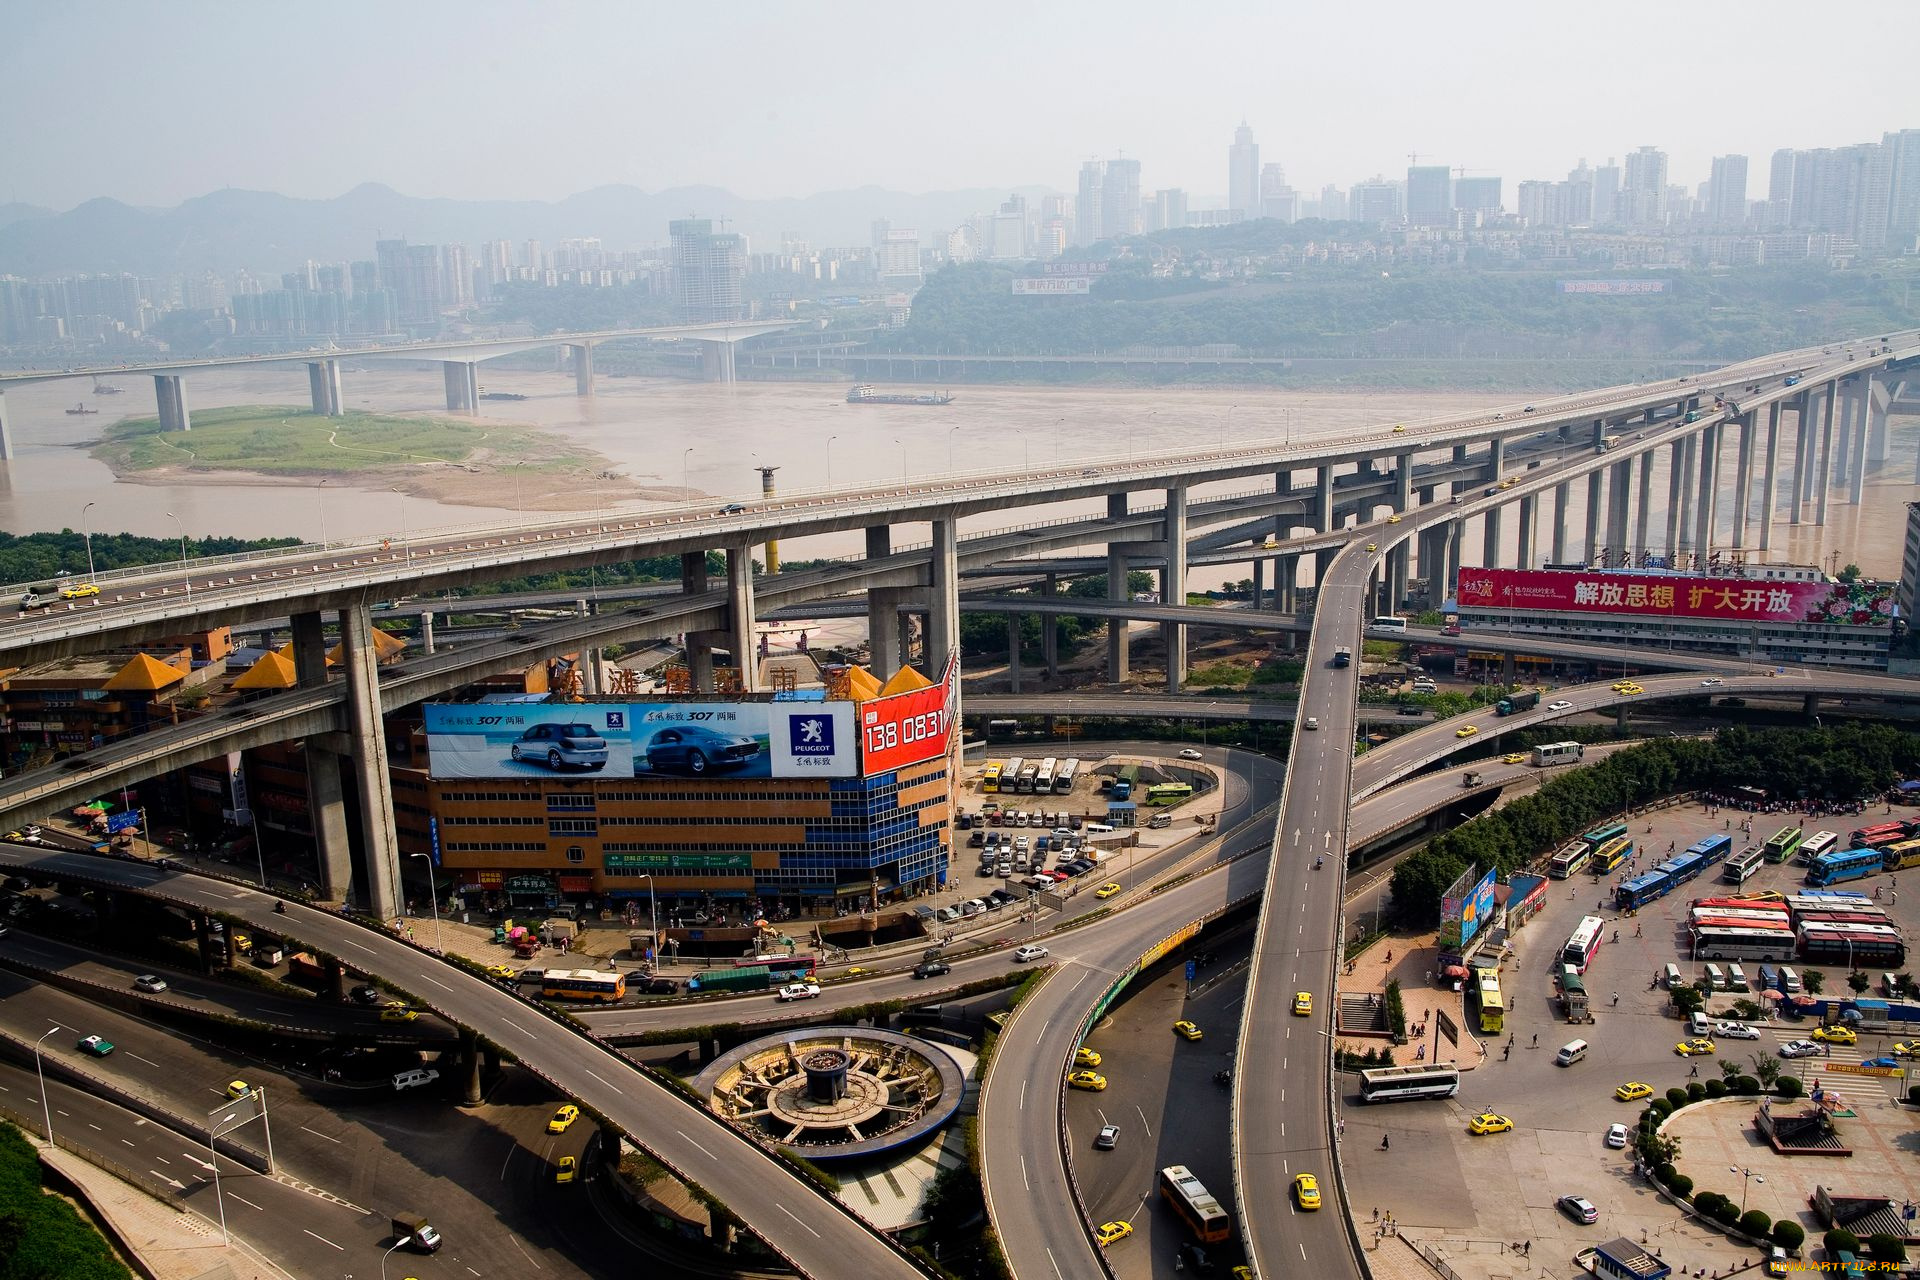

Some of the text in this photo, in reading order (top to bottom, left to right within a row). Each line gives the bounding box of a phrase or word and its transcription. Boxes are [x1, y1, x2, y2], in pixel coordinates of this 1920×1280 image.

[1574, 580, 1793, 613] 解放思想 扩大开放
[476, 715, 503, 725] 307
[505, 715, 525, 725] 两厢
[686, 711, 715, 721] 307
[716, 711, 737, 721] 两厢
[866, 709, 944, 753] 138 0831
